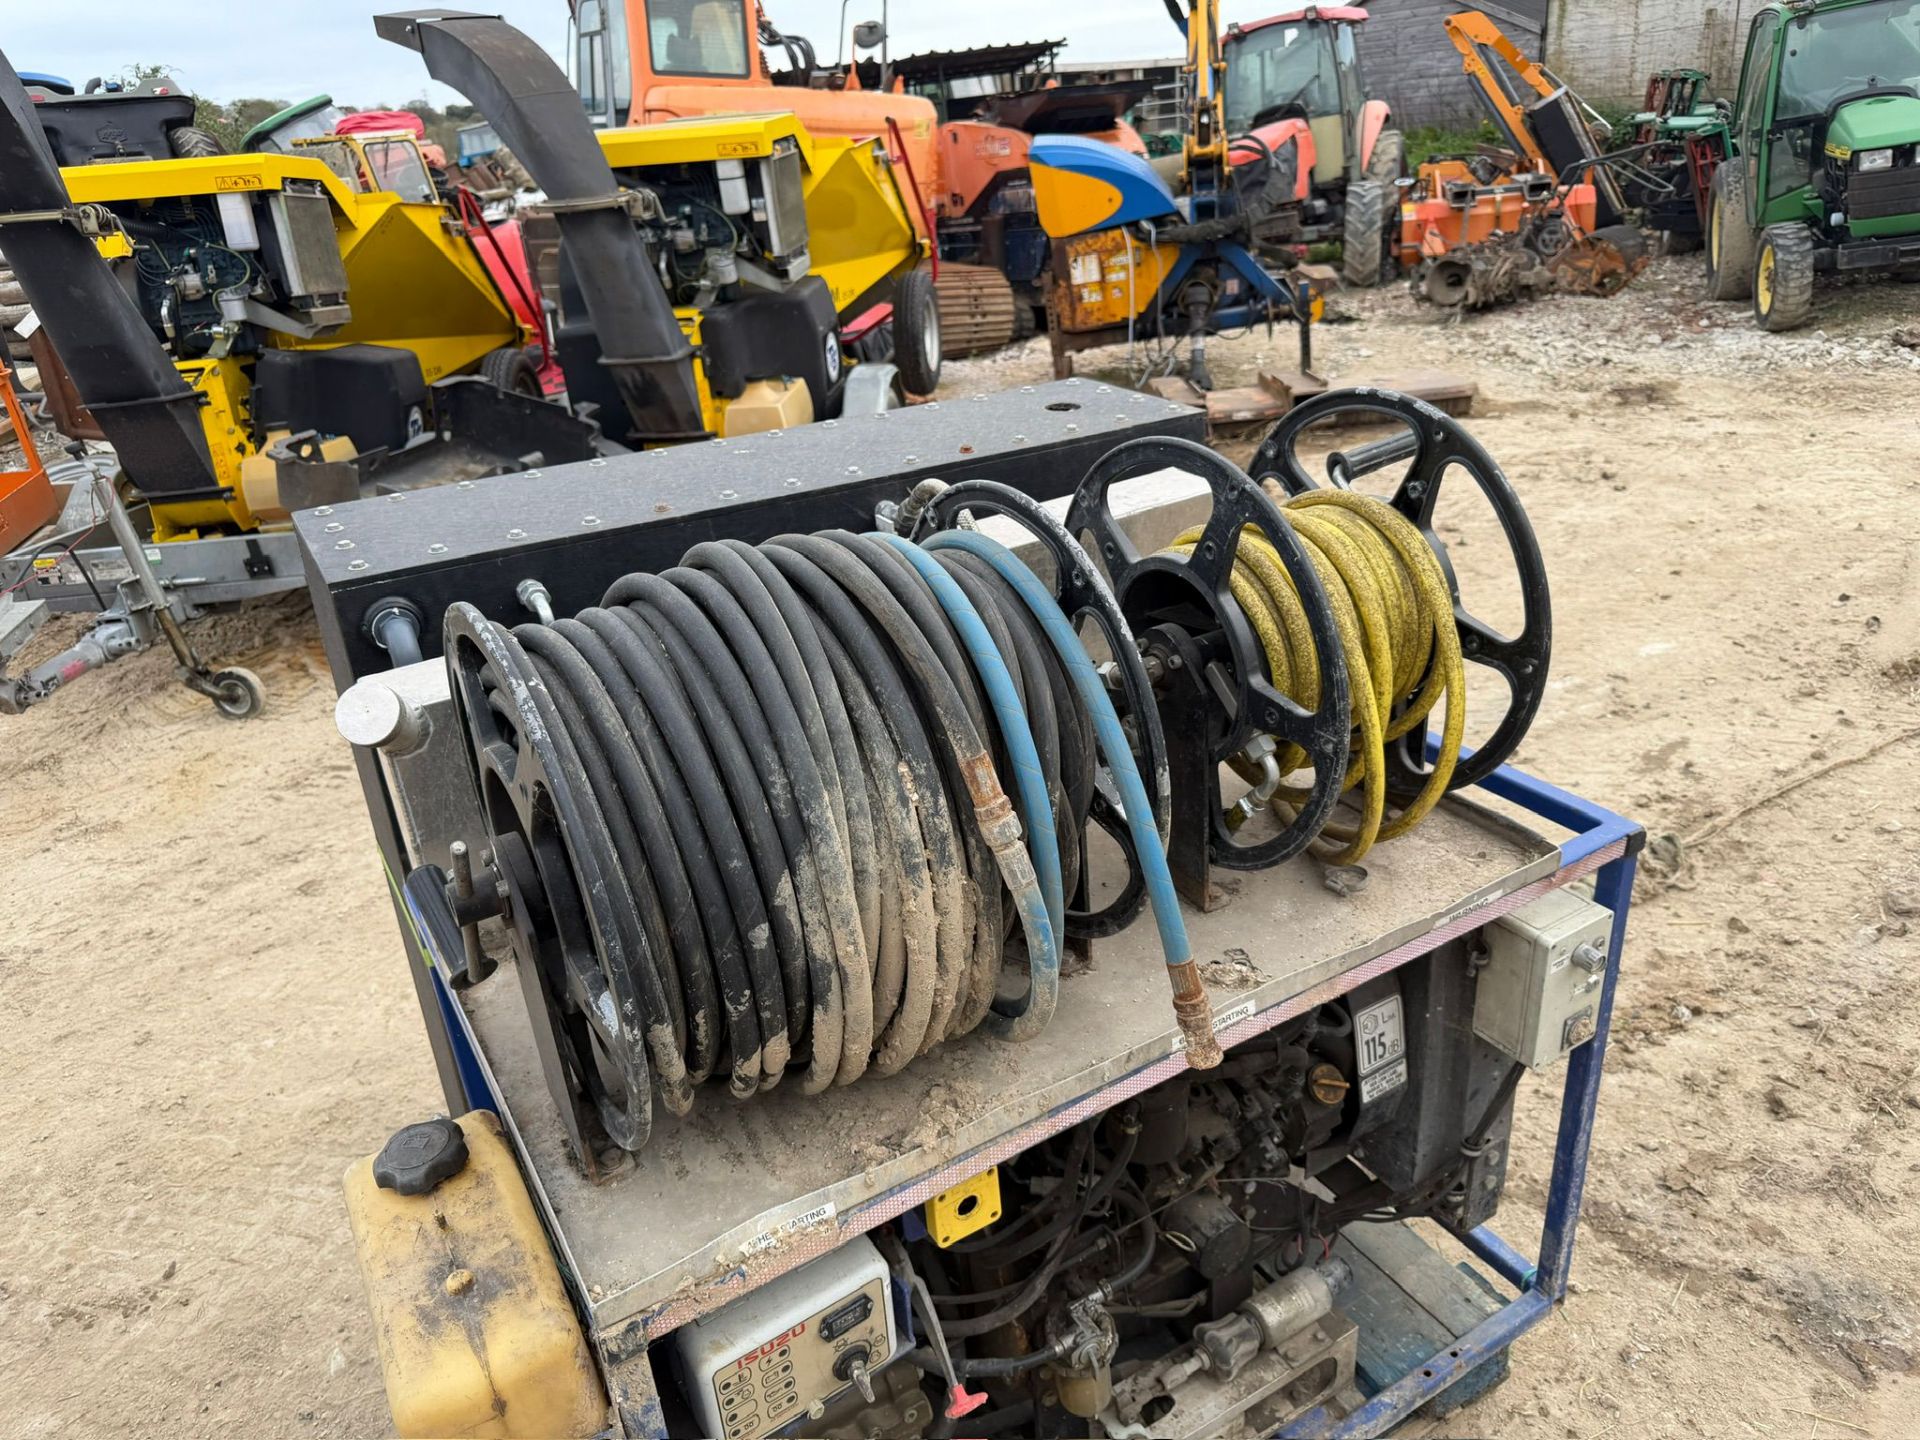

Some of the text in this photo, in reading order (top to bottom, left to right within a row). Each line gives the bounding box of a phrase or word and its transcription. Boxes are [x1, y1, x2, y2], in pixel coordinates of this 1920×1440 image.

[1212, 1006, 1249, 1030] STARTING
[1364, 1031, 1387, 1065] 115
[737, 1323, 806, 1370] ISUZU
